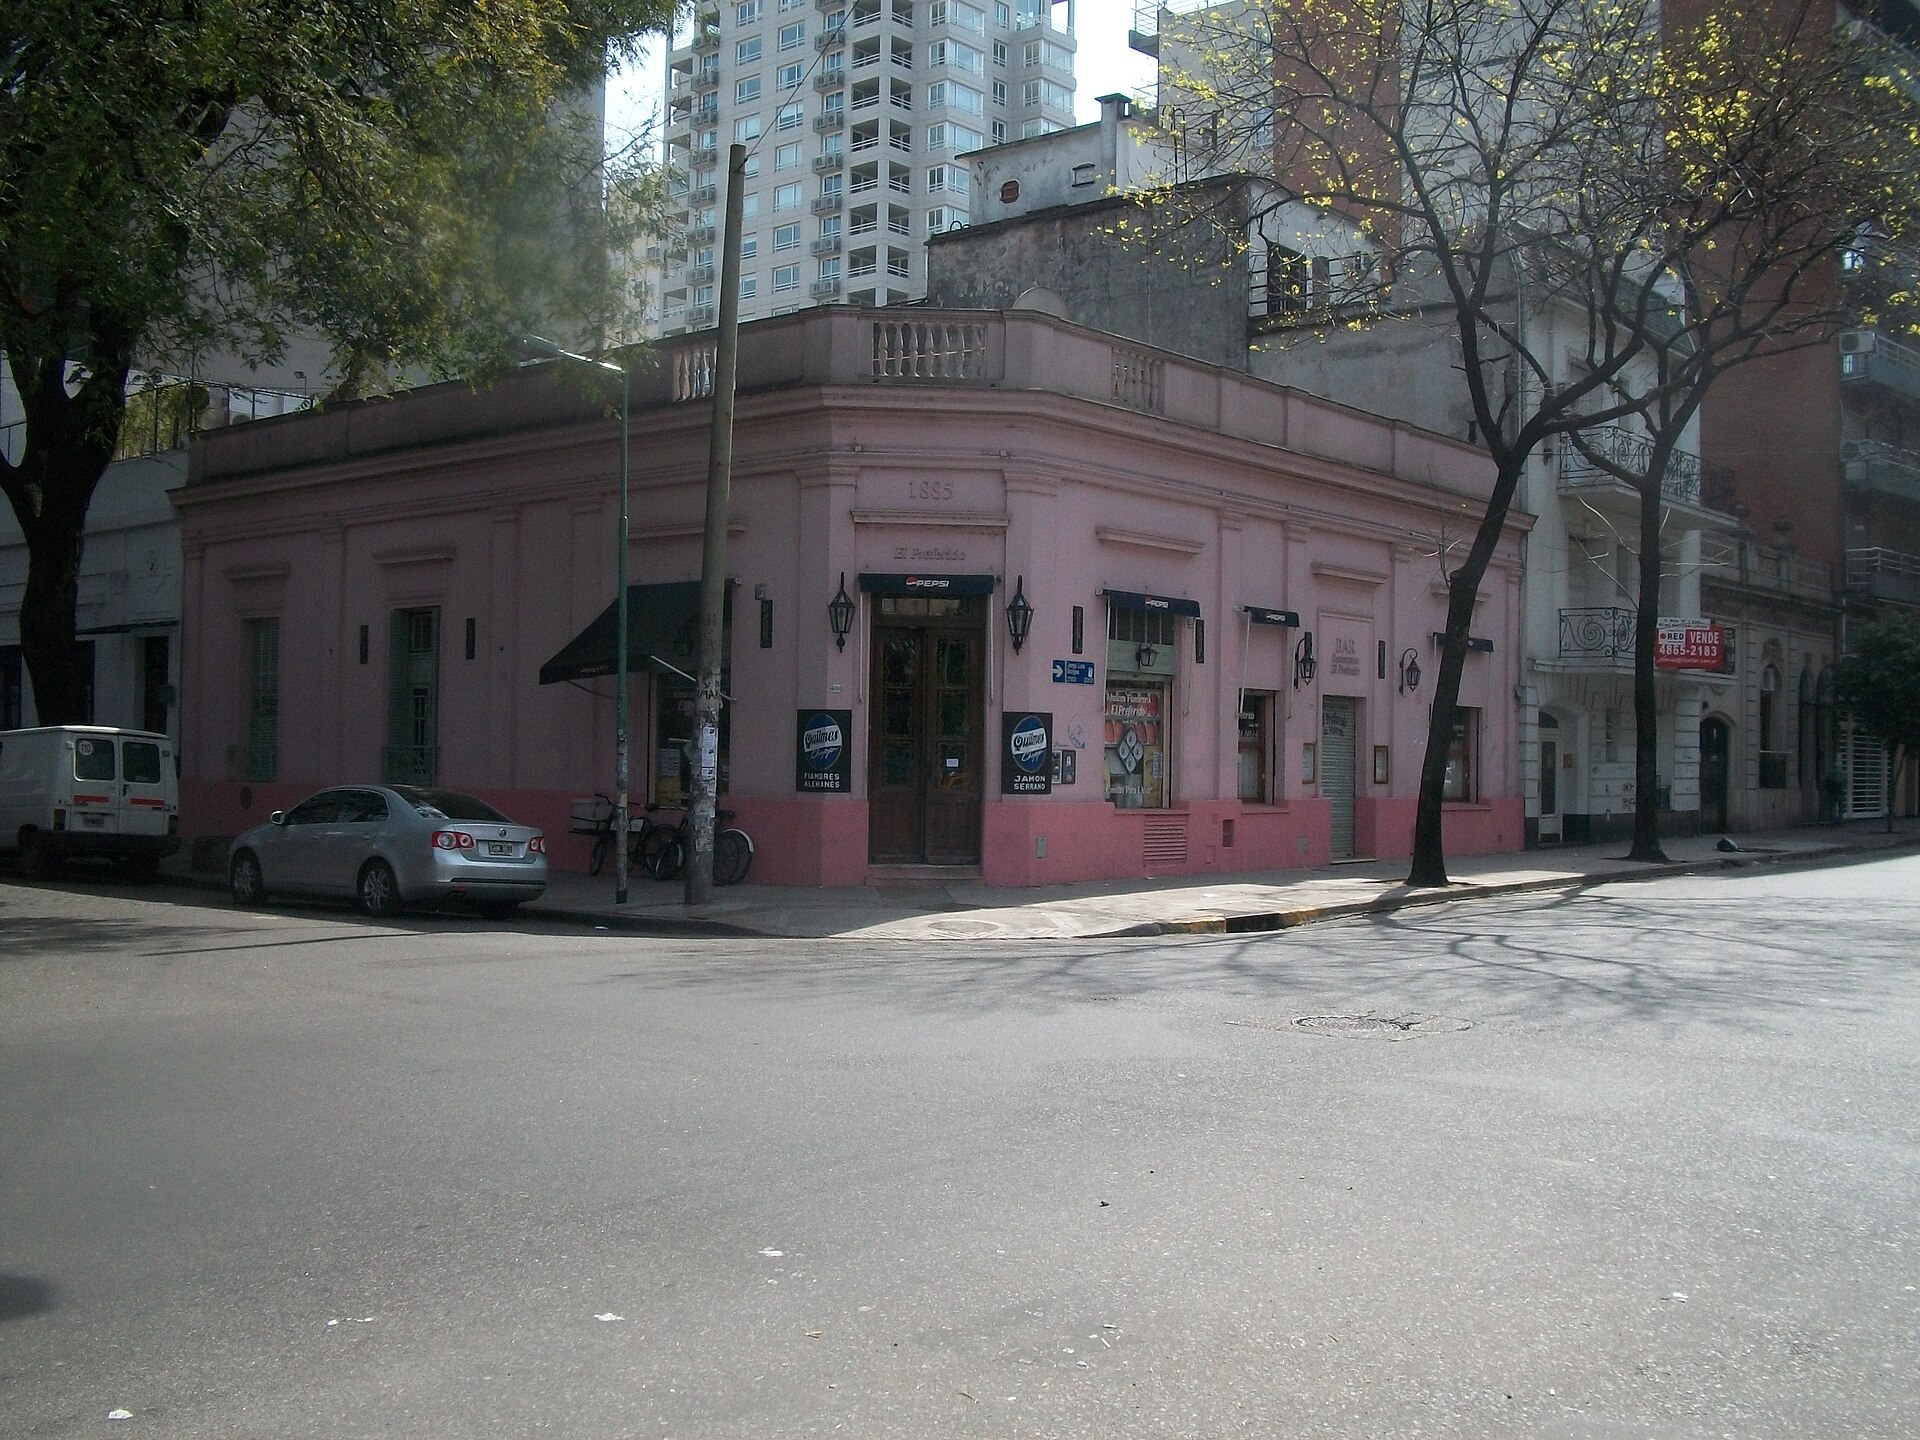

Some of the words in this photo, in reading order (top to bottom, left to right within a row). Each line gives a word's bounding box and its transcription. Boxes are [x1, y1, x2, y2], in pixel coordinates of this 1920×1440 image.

[908, 481, 954, 500] 1885
[916, 579, 950, 588] PEPSI
[1667, 632, 1684, 640] RED
[1690, 631, 1719, 643] VENDE
[1659, 645, 1717, 657] 4865-2183
[805, 730, 839, 748] Quilmes
[1013, 732, 1045, 751] Quilmes
